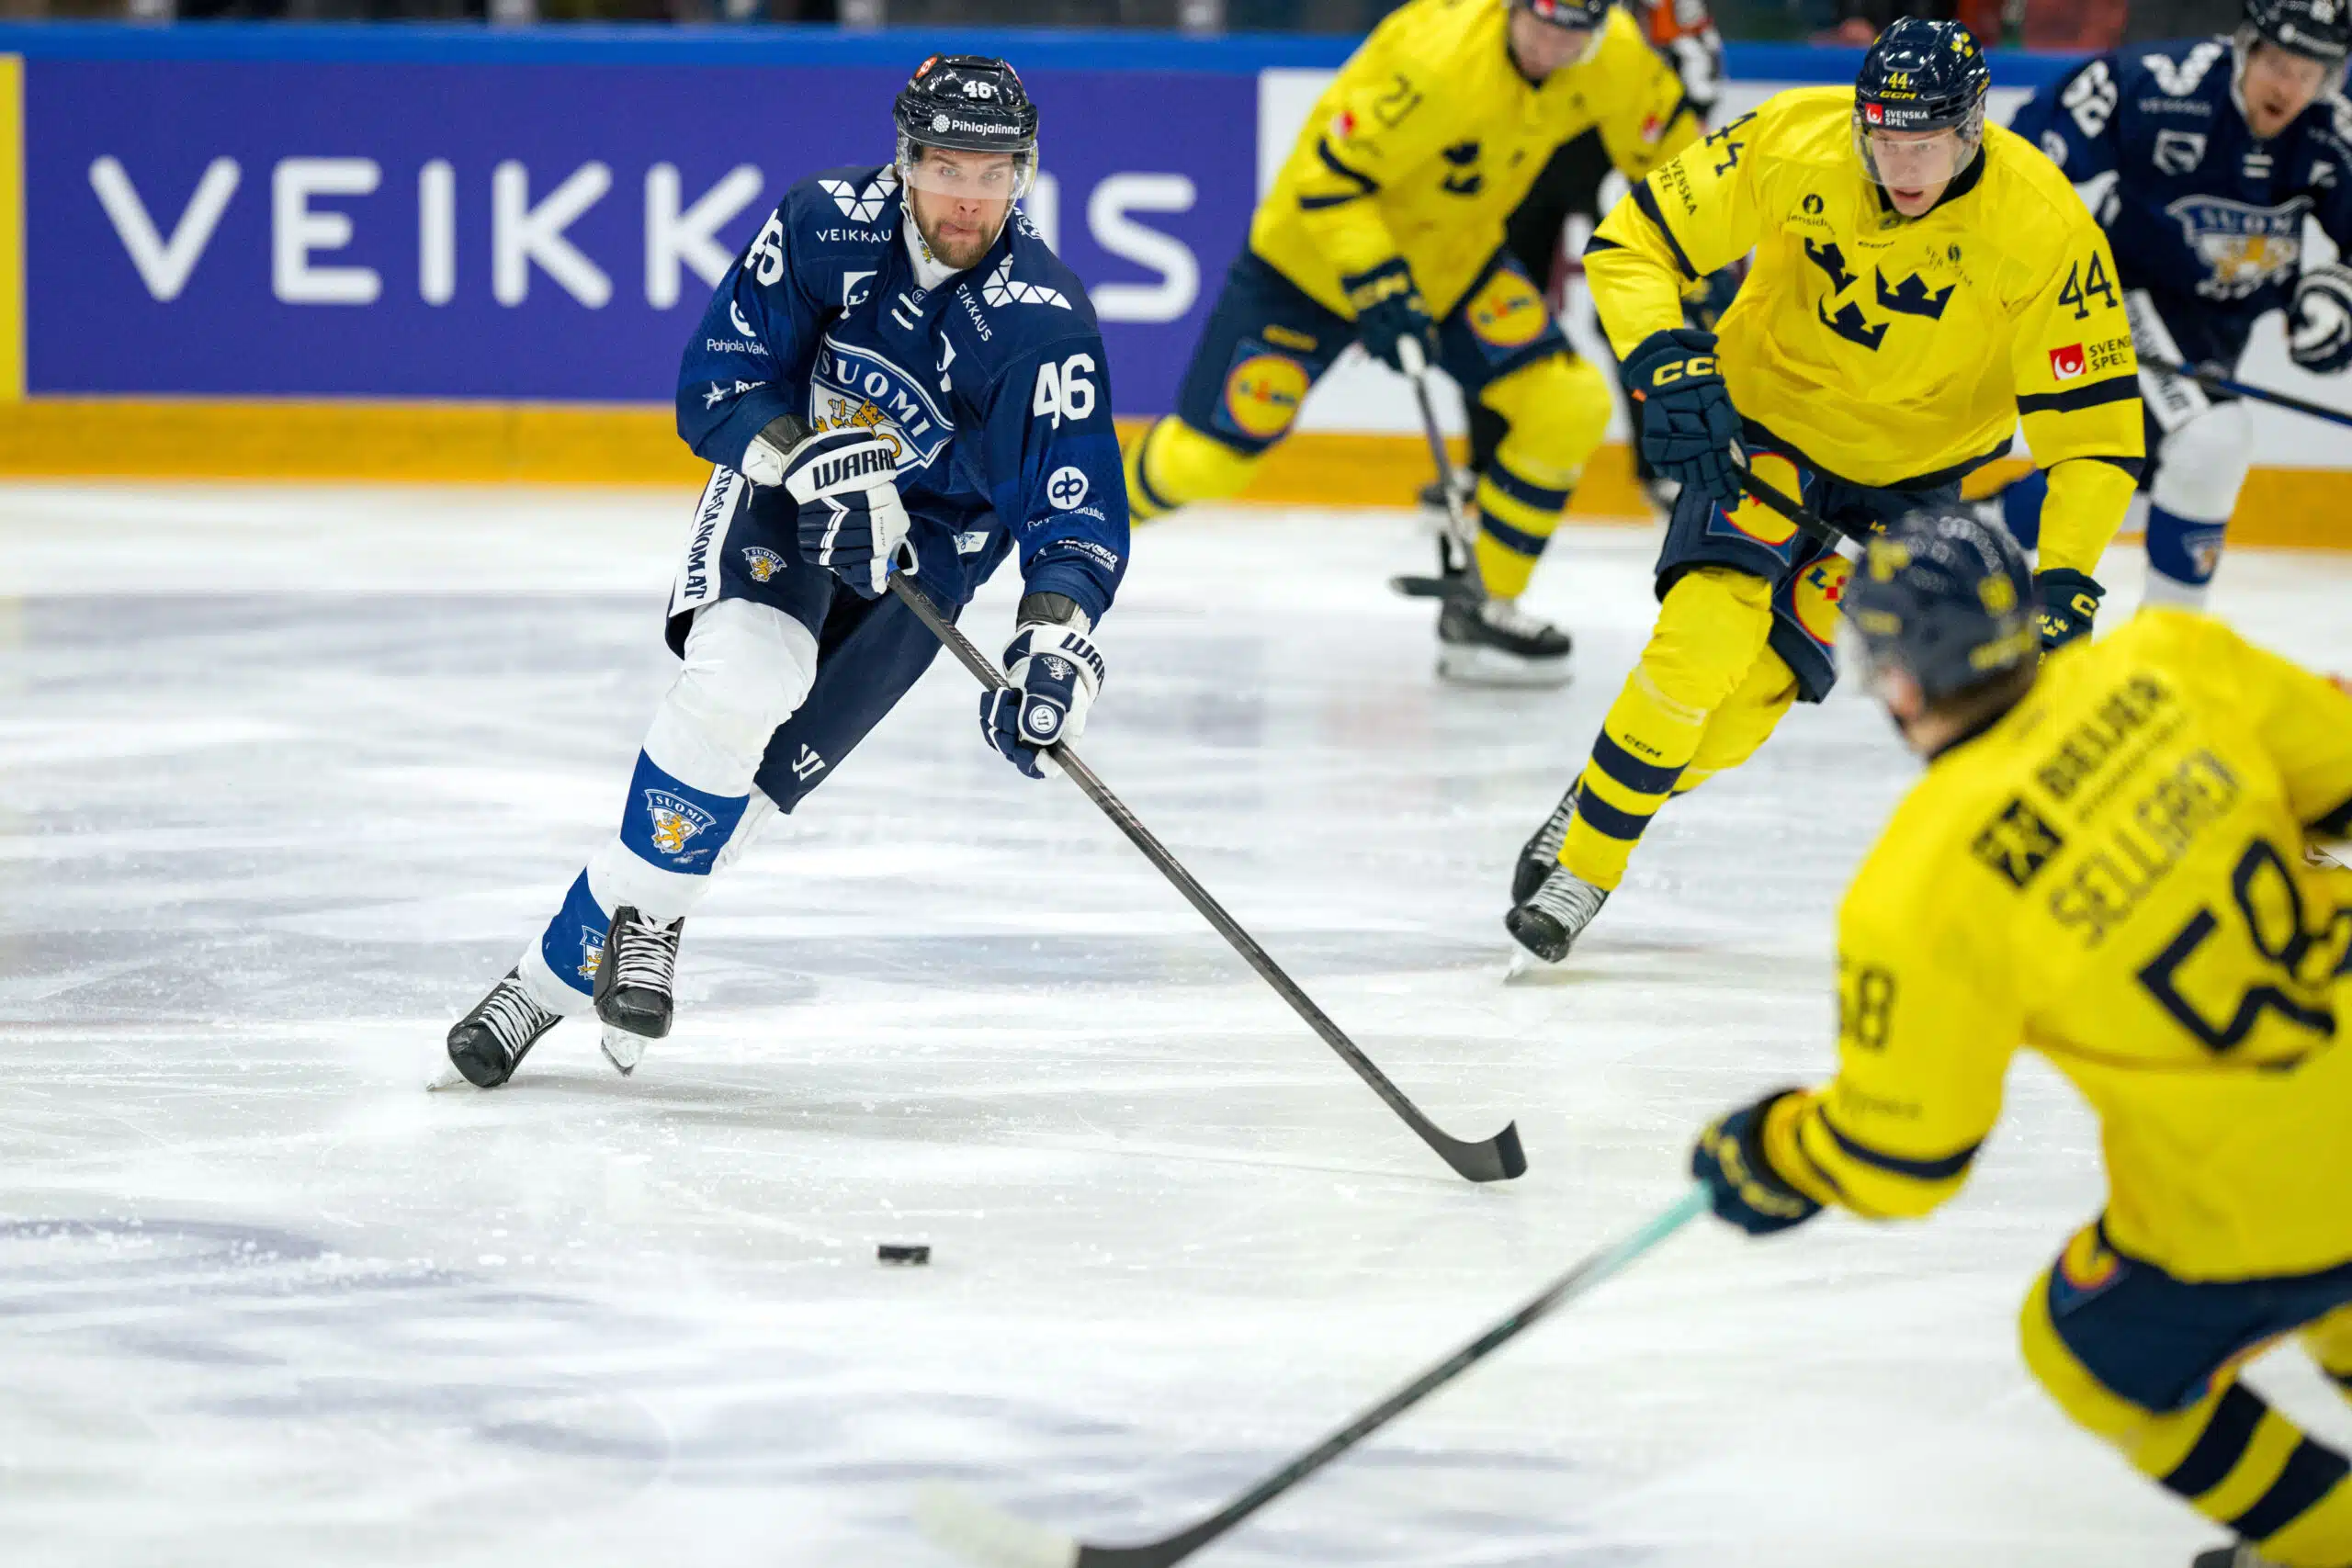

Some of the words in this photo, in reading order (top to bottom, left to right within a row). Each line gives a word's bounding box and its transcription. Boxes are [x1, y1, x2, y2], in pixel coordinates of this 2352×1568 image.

[962, 80, 992, 99] 46
[1887, 71, 1909, 90] 44
[1879, 90, 1917, 100] CCM
[1884, 109, 1928, 119] SVENSKA
[1884, 118, 1908, 127] SPEL
[951, 119, 1021, 136] Pihlajalinna
[89, 153, 1201, 324] VEIKKS
[816, 229, 892, 243] VEIKKAU
[2058, 249, 2118, 320] 44
[956, 283, 993, 342] EIKKAUS
[707, 338, 745, 353] Pohjola
[1652, 356, 1724, 387] CC
[2091, 352, 2129, 372] SPEL
[820, 350, 932, 438] SUOMI
[1033, 353, 1095, 430] 46
[751, 549, 780, 563] SUOMI
[1623, 733, 1664, 759] CCM
[655, 795, 705, 824] SUOMI
